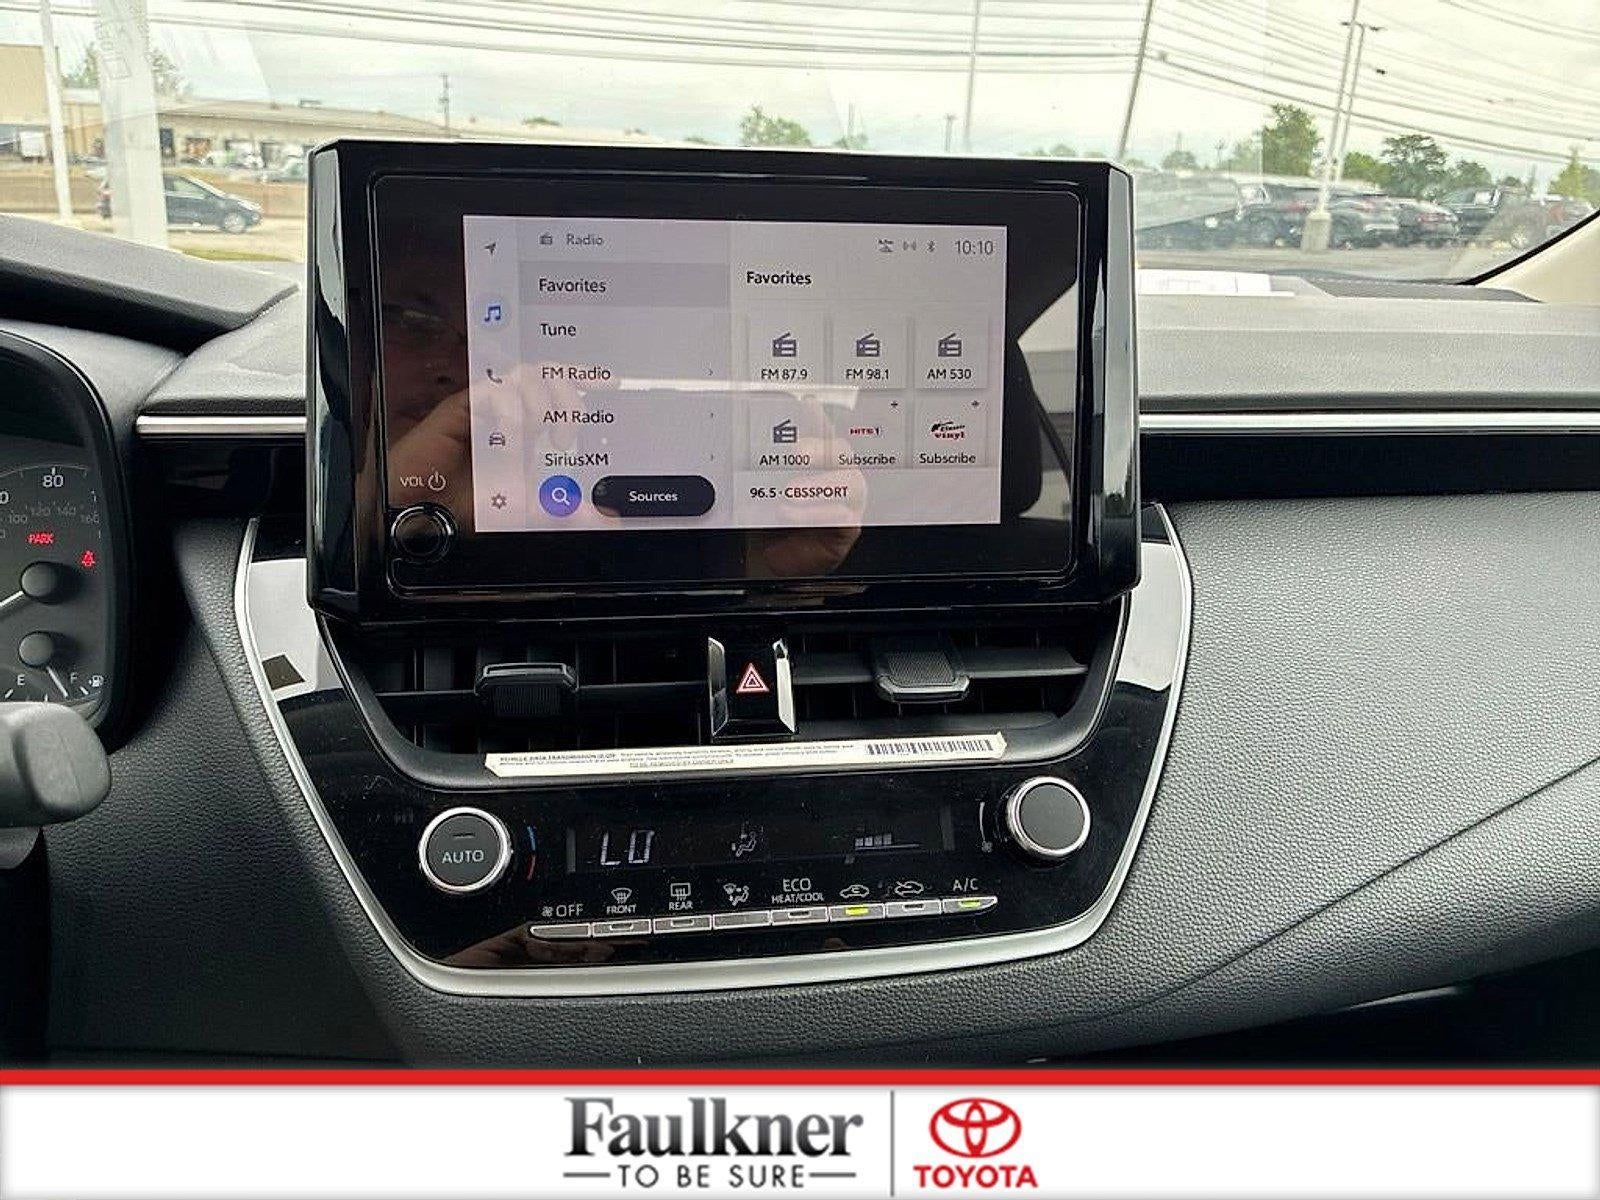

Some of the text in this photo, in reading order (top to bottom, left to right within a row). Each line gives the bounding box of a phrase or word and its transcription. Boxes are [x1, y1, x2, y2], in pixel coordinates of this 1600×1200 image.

[566, 233, 604, 245] Radio
[955, 240, 994, 255] 10:10
[746, 271, 812, 285] Favorites
[538, 278, 607, 293] Favorites
[540, 323, 577, 336] Tune
[541, 367, 611, 380] FM Radio
[761, 369, 808, 380] FM 87.9
[846, 369, 889, 380] FM 98.1
[927, 369, 972, 380] AM 530
[543, 411, 614, 424] AM Radio
[544, 453, 609, 467] SiriusXM
[759, 454, 810, 466] AM 1000
[838, 453, 897, 465] Subscribe
[919, 453, 977, 464] Subscribe
[42, 475, 64, 488] 80
[400, 476, 425, 488] VOL
[629, 490, 679, 502] Sources
[749, 486, 849, 498] 96.5 CBSSPORT
[16, 674, 26, 686] E
[441, 850, 485, 865] AUTO
[782, 877, 812, 893] ECO
[952, 877, 979, 892] A/C
[771, 893, 825, 905] HEAT/COOL
[555, 903, 585, 918] OFF
[606, 904, 638, 915] FRONT
[667, 900, 694, 911] REAR
